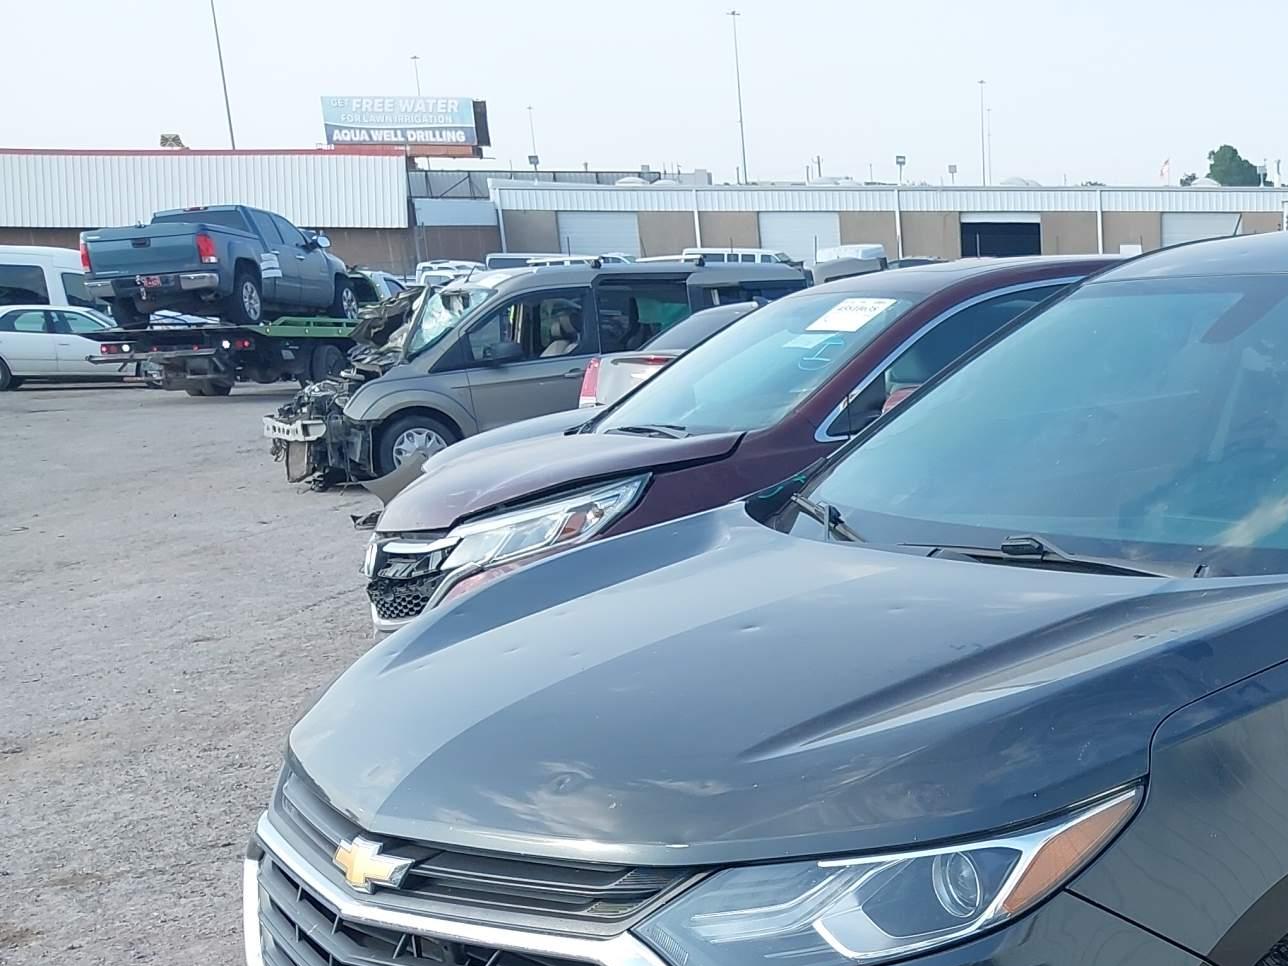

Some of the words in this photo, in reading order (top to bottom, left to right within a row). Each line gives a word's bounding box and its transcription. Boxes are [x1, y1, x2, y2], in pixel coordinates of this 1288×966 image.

[351, 98, 394, 112] FREE
[399, 98, 459, 113] WATER
[341, 114, 362, 123] FOR
[362, 114, 393, 123] LAWN
[394, 114, 453, 123] IRRIGATION
[332, 129, 370, 141] AQUA
[370, 129, 405, 141] WELL
[407, 130, 466, 142] DRILLING
